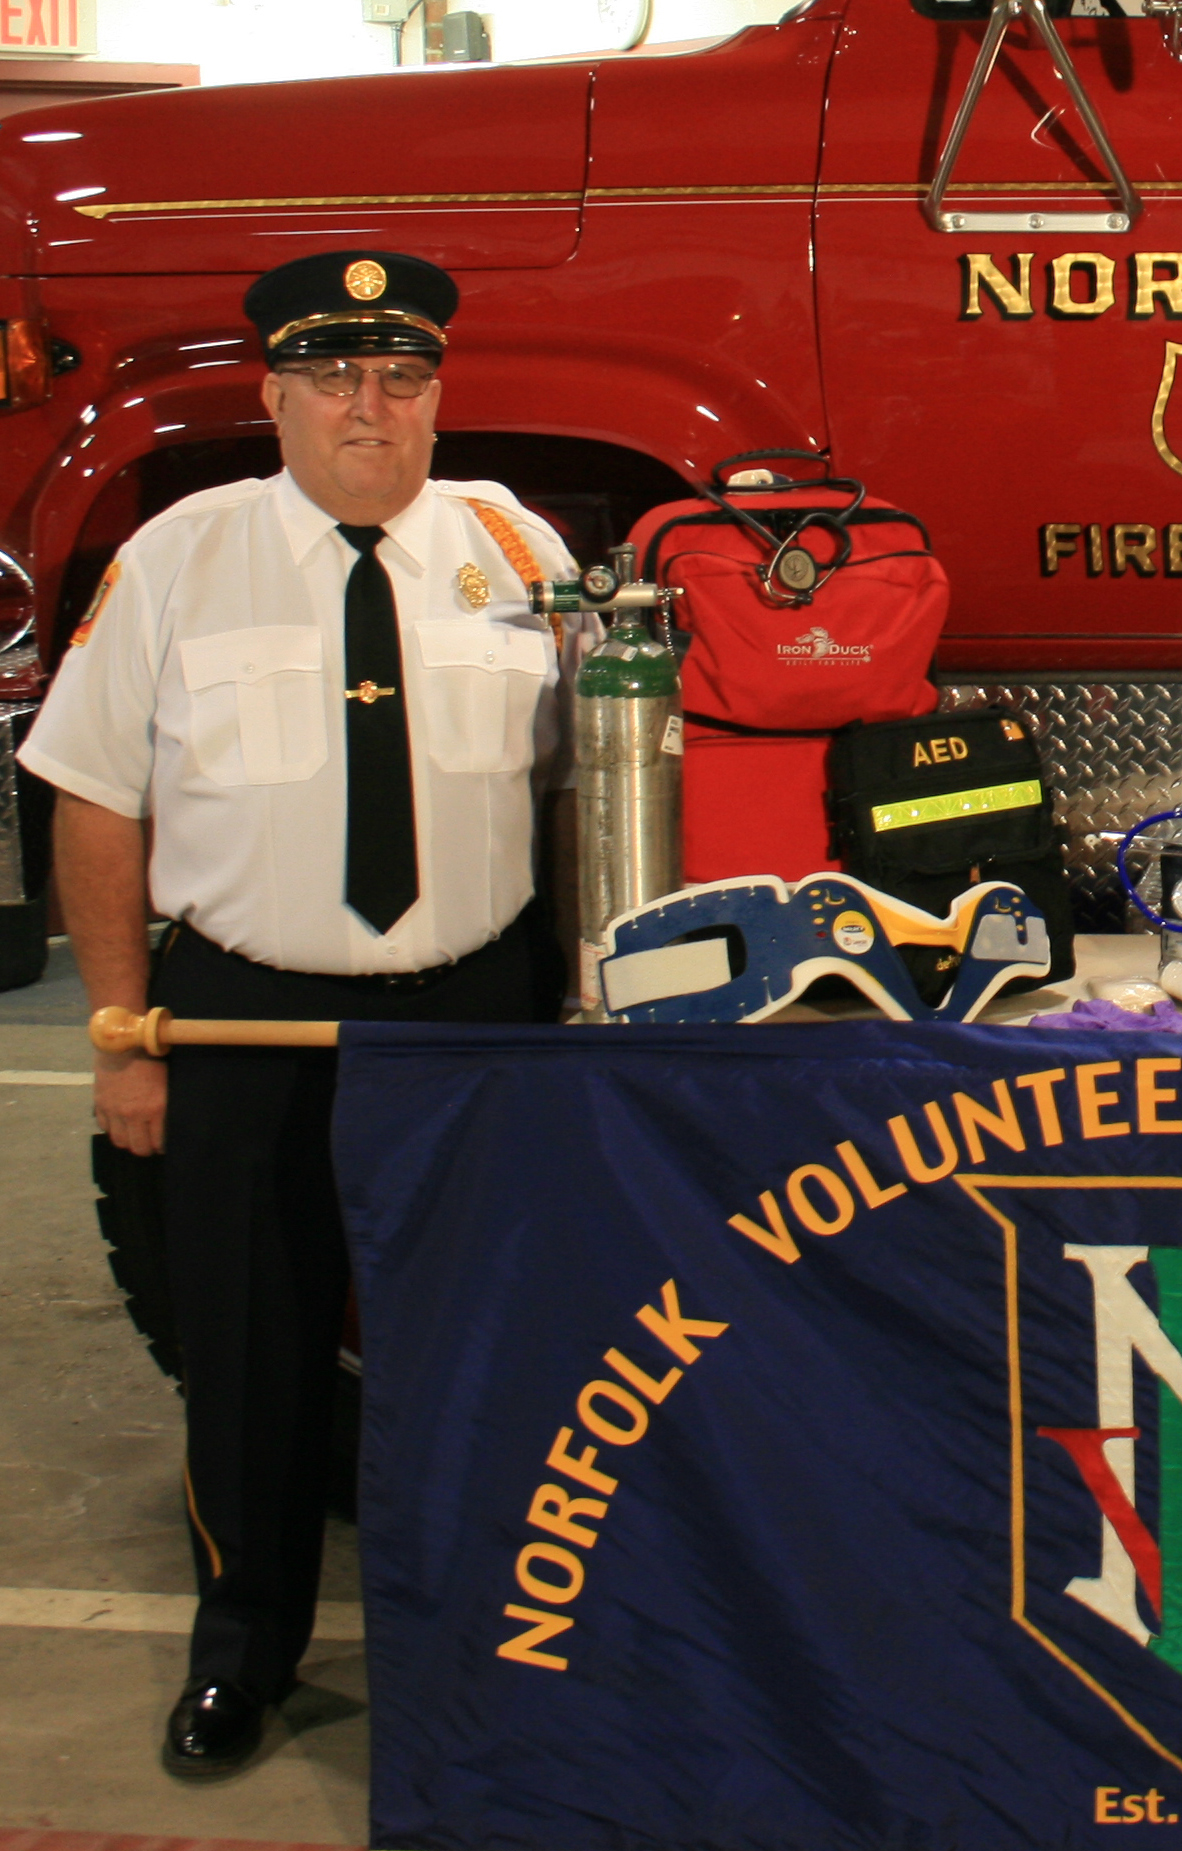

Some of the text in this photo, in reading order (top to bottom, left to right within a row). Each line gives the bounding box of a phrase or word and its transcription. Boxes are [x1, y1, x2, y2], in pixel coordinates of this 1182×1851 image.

[776, 643, 870, 655] IRON DUCK
[914, 736, 969, 767] AED
[496, 1277, 730, 1671] NORFOLK
[1094, 1786, 1180, 1825] Est.
